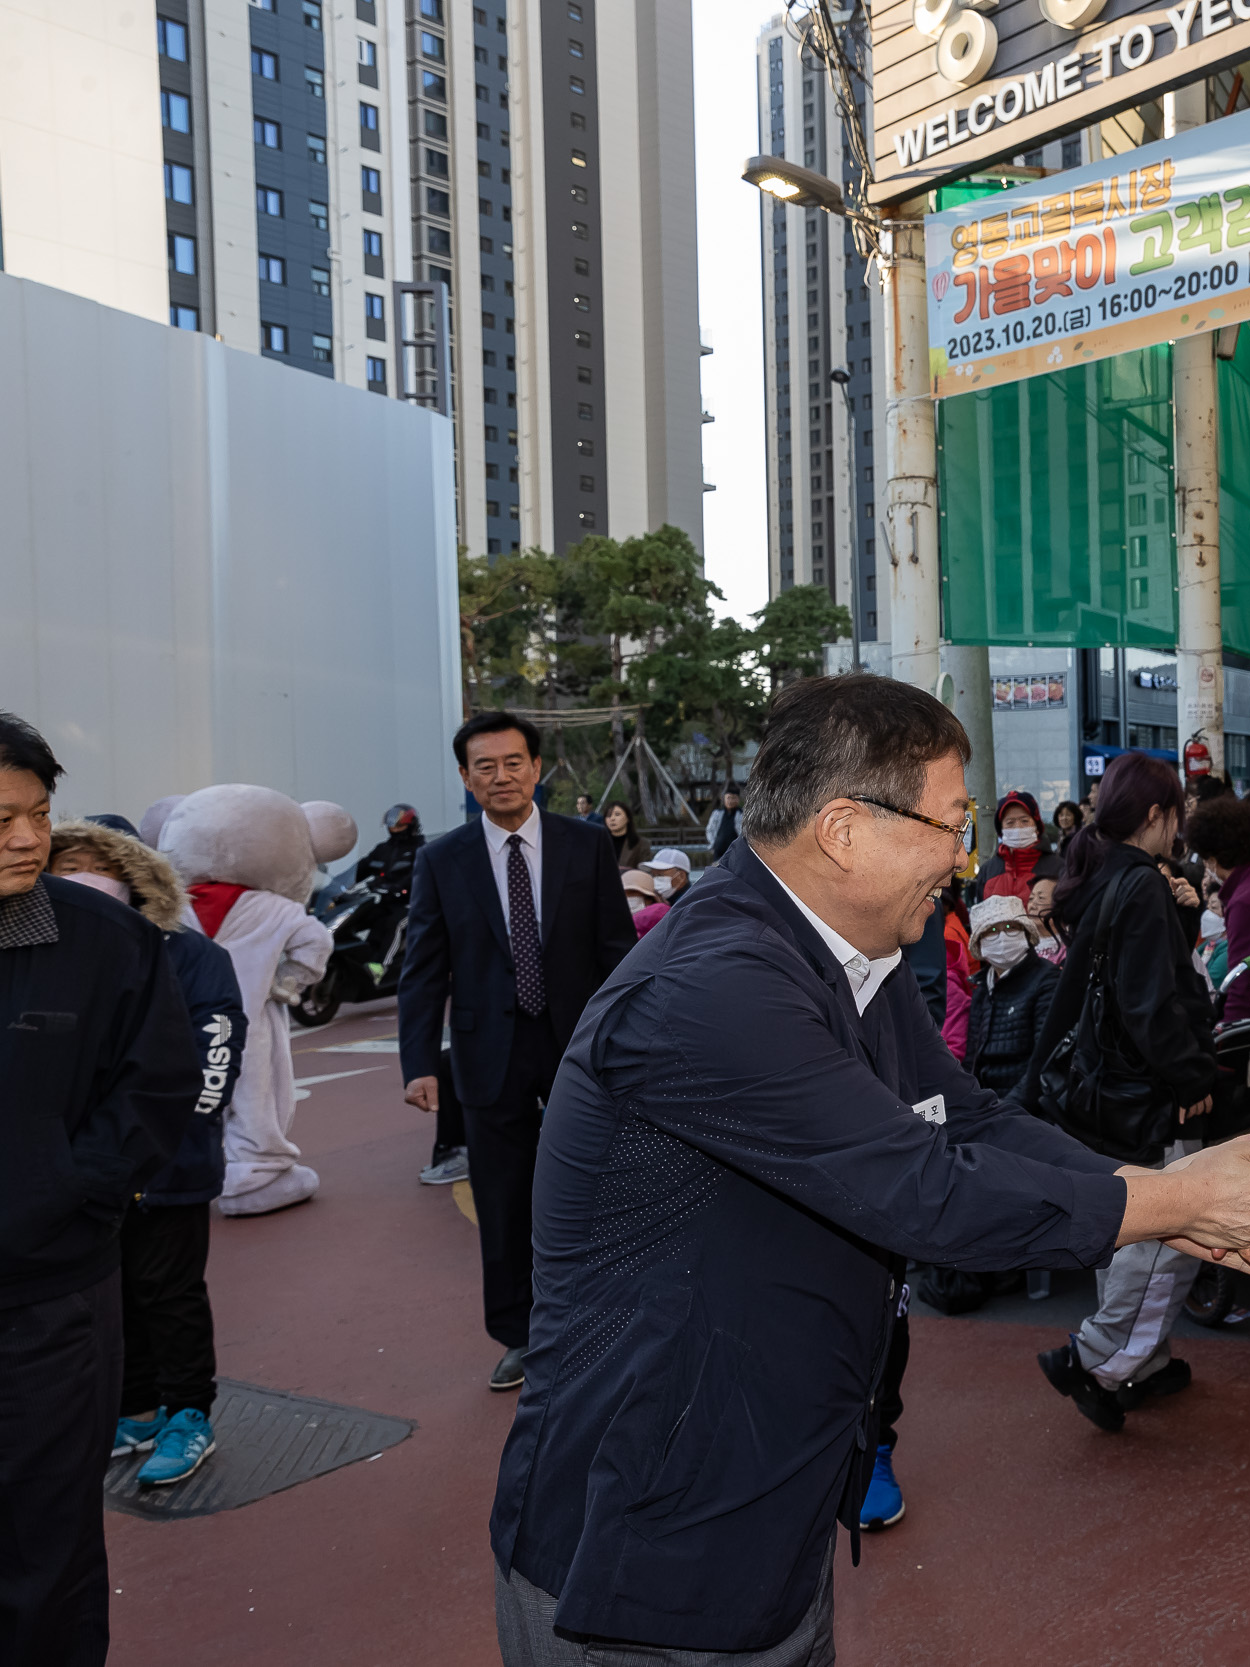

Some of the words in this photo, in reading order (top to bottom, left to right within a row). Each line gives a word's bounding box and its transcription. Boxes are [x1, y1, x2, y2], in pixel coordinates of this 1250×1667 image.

[892, 52, 1085, 168] WELCOME
[1092, 23, 1155, 79] TO
[951, 159, 1176, 268] 영동교골목시장
[947, 305, 1091, 360] 2023.10.20.(금)
[1097, 259, 1239, 316] 16:00~20:00
[953, 227, 1117, 325] 가을맞이
